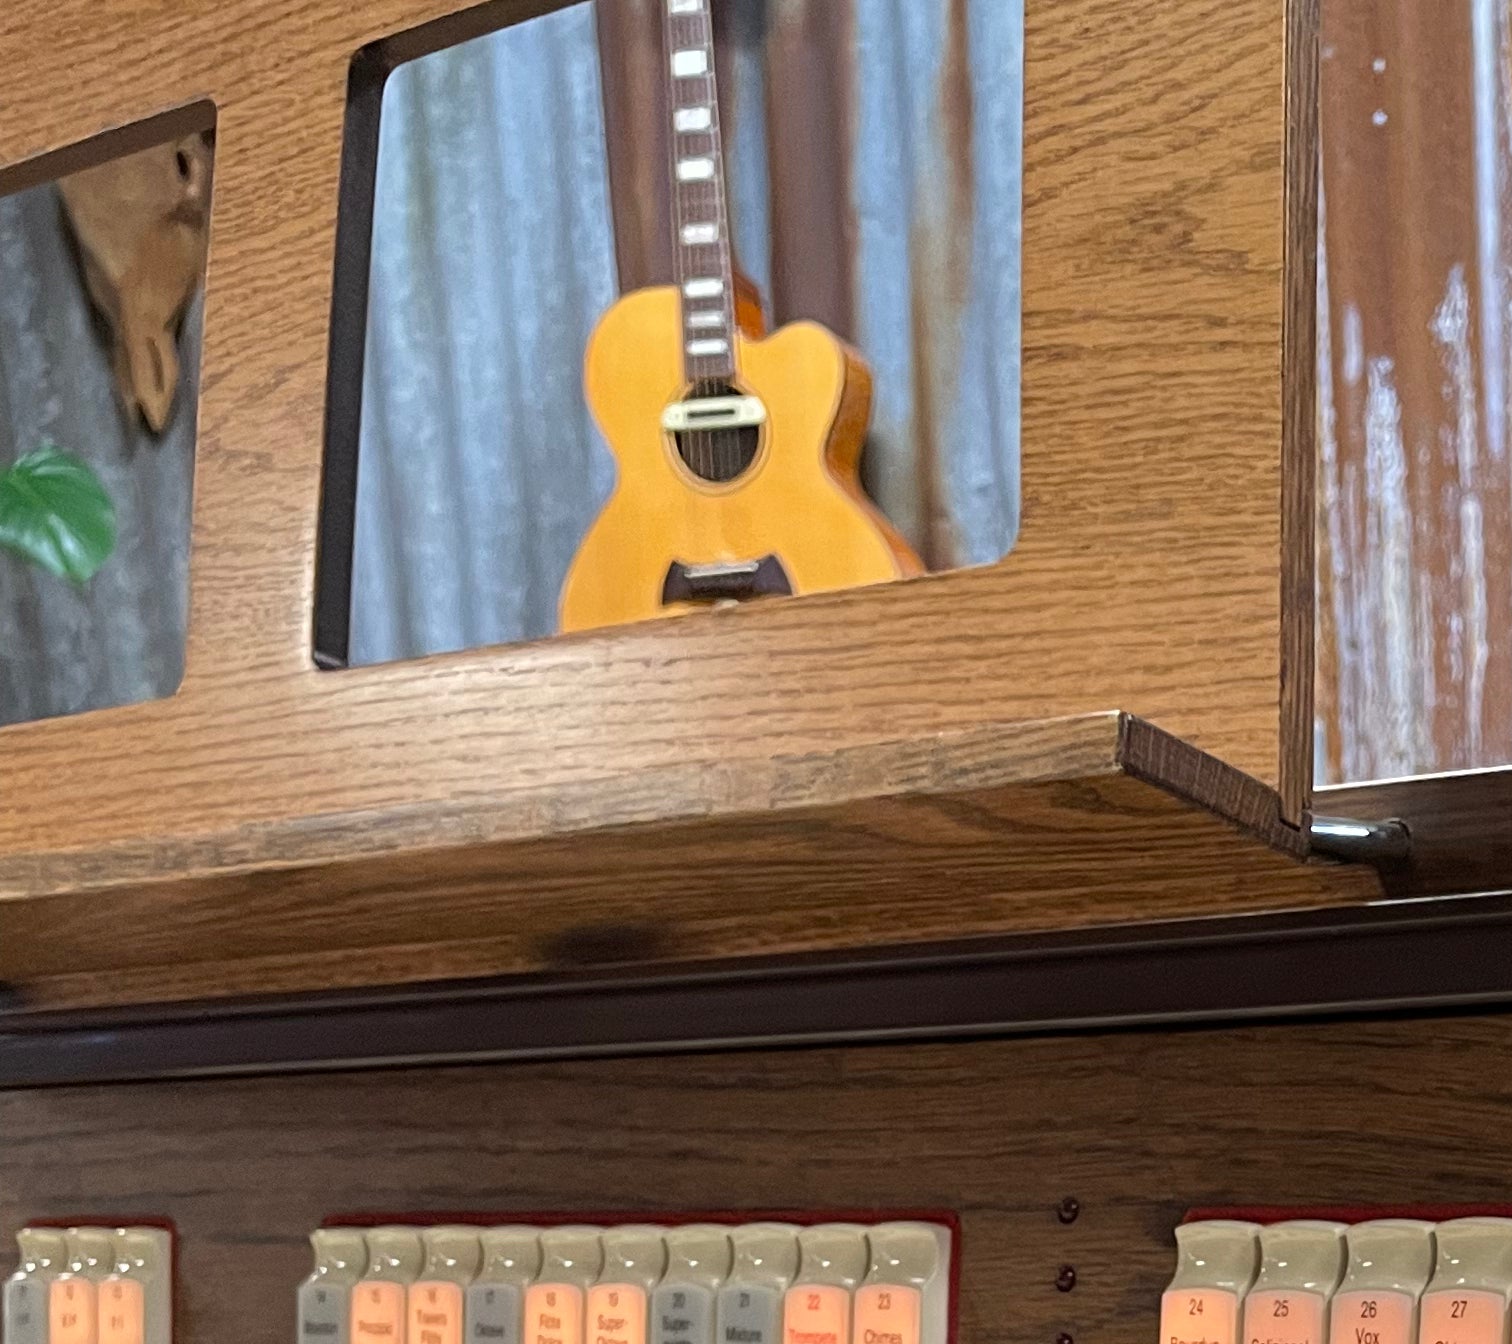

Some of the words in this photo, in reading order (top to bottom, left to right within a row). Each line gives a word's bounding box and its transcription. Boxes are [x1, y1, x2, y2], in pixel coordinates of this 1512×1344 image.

[1189, 1299, 1204, 1316] 24
[1273, 1300, 1289, 1317] 25
[1360, 1300, 1377, 1319] 26
[1450, 1300, 1468, 1318] 27
